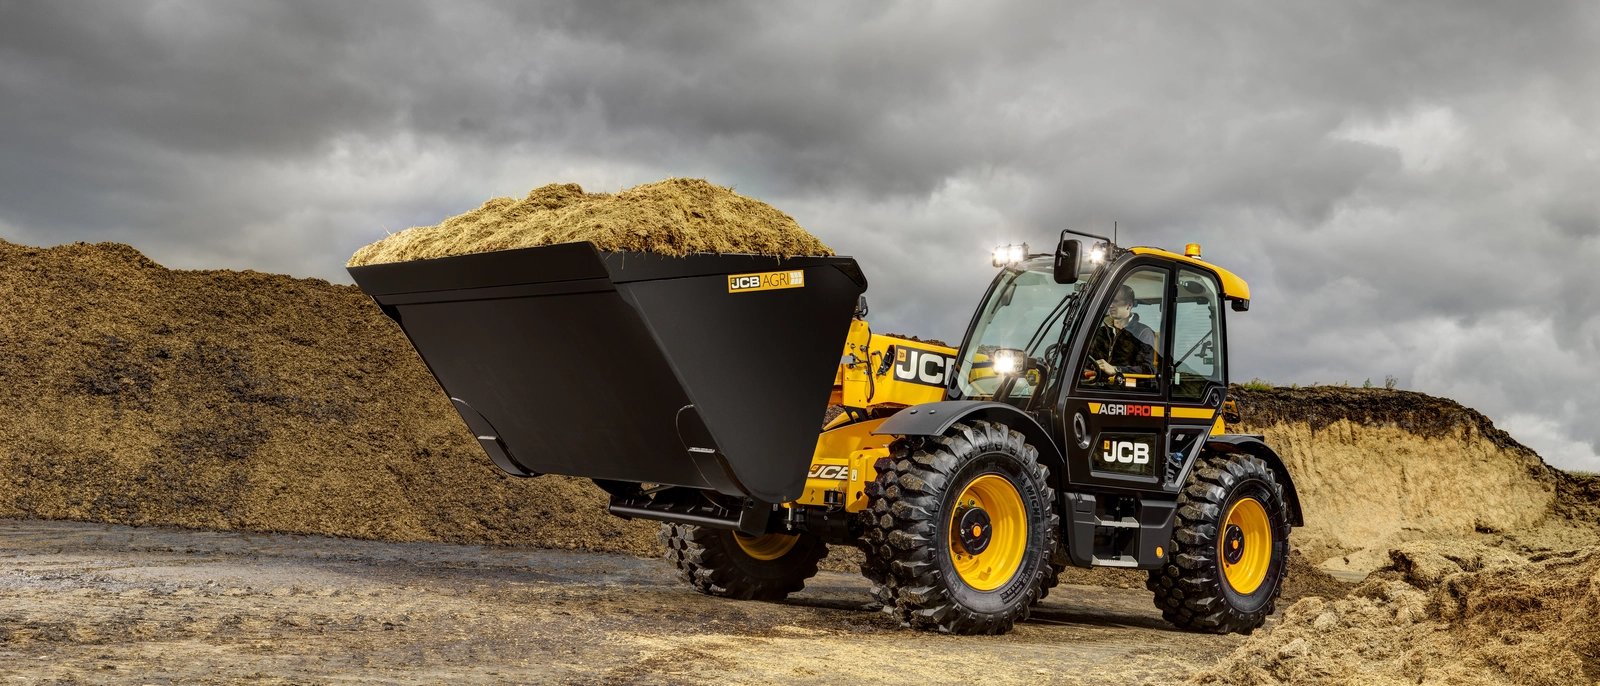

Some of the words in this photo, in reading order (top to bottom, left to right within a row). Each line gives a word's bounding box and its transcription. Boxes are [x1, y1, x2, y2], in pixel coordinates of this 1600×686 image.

[731, 276, 760, 289] JCB
[762, 273, 790, 287] AGRI
[1099, 403, 1152, 417] AGRIPRO
[1103, 440, 1150, 464] JCB
